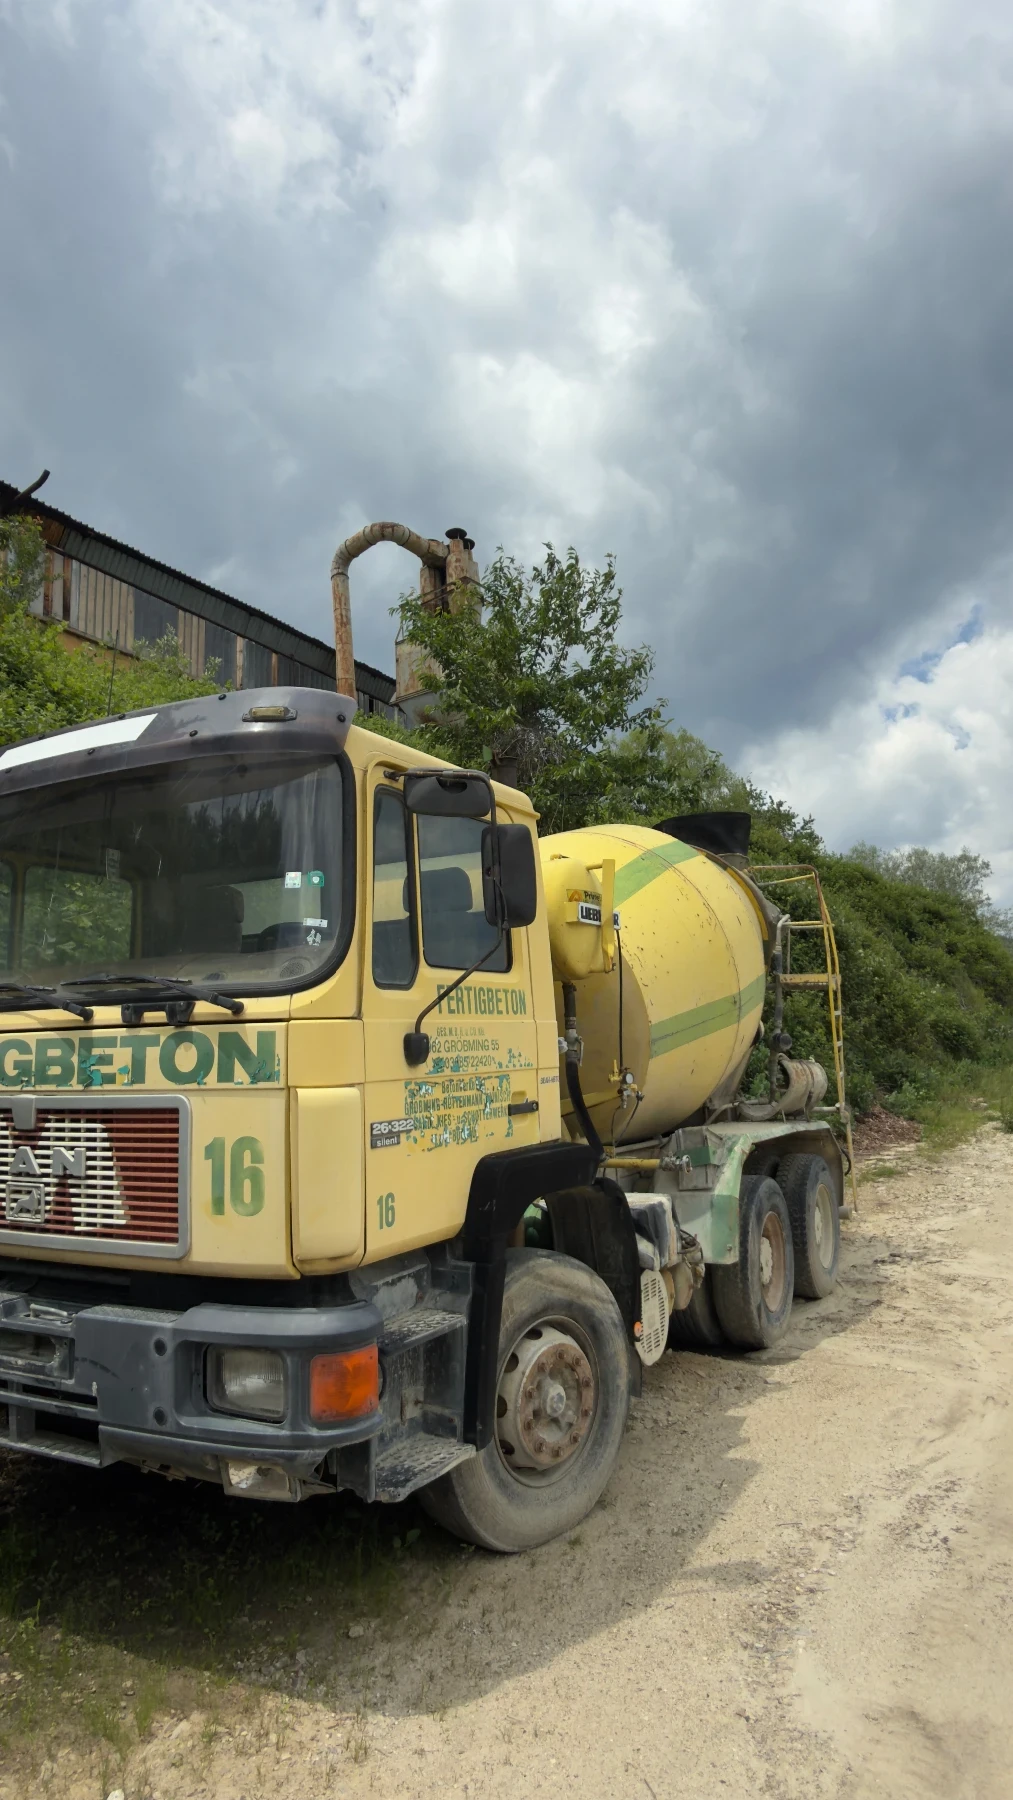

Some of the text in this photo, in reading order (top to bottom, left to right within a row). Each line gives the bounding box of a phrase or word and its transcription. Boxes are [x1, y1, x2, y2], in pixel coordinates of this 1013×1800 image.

[436, 984, 527, 1015] FERTIGBETON
[376, 1136, 398, 1147] silent
[204, 1135, 265, 1217] 16
[377, 1192, 395, 1230] 16
